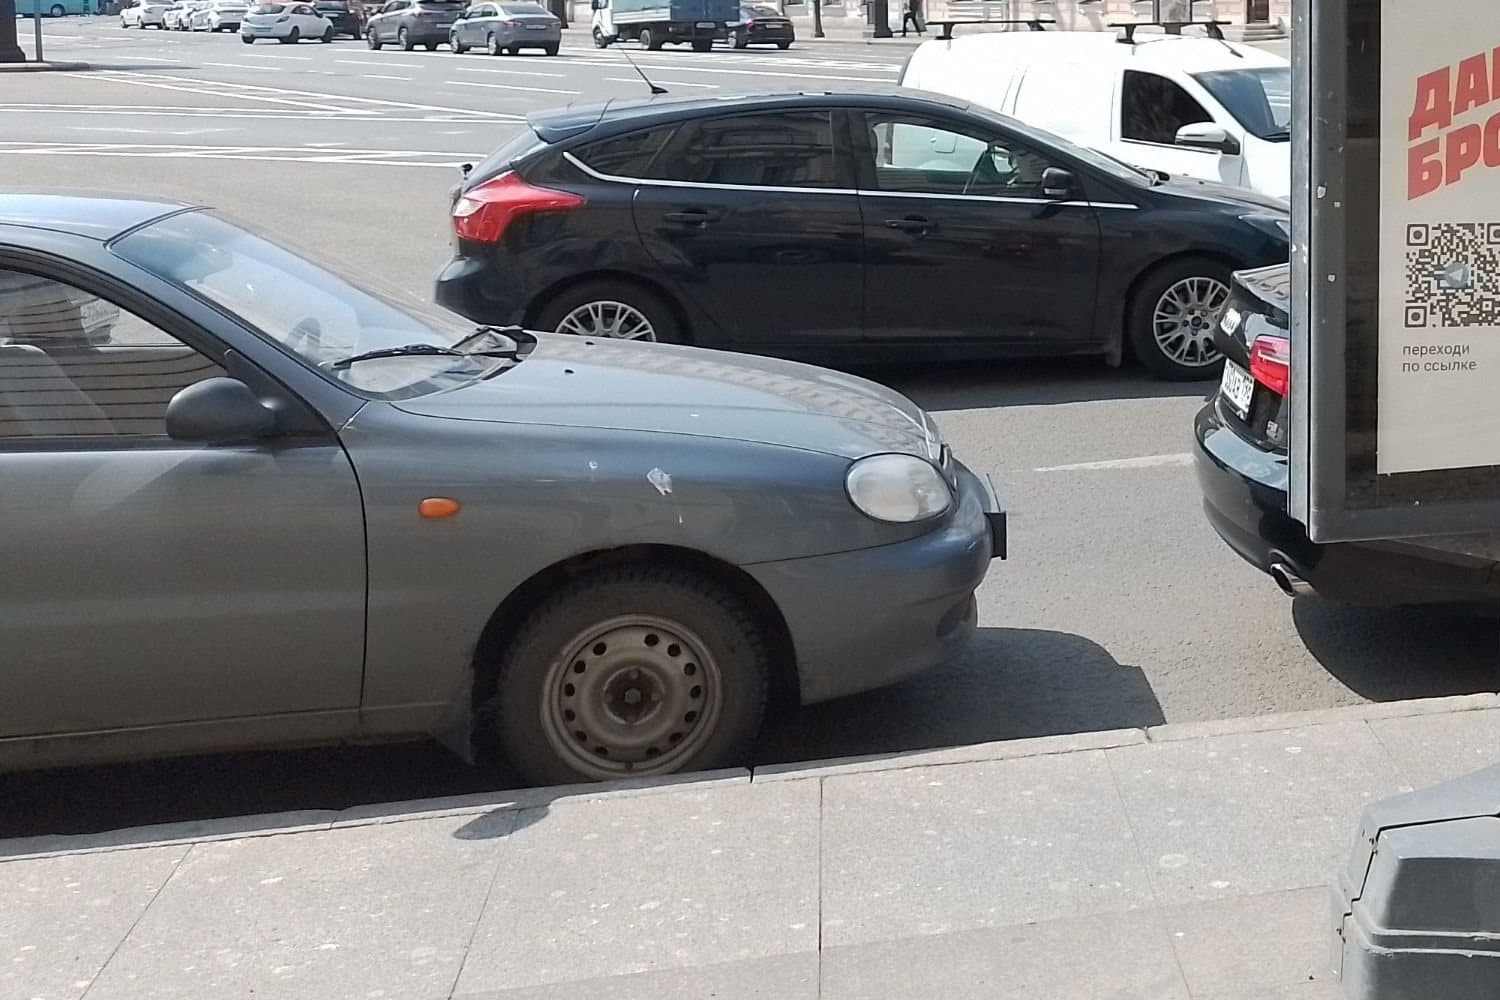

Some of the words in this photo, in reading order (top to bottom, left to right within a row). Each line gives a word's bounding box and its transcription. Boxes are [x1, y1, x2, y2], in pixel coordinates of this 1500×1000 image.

[1402, 344, 1471, 358] переходи
[1402, 361, 1420, 374] по
[1423, 359, 1478, 373] ссылке
